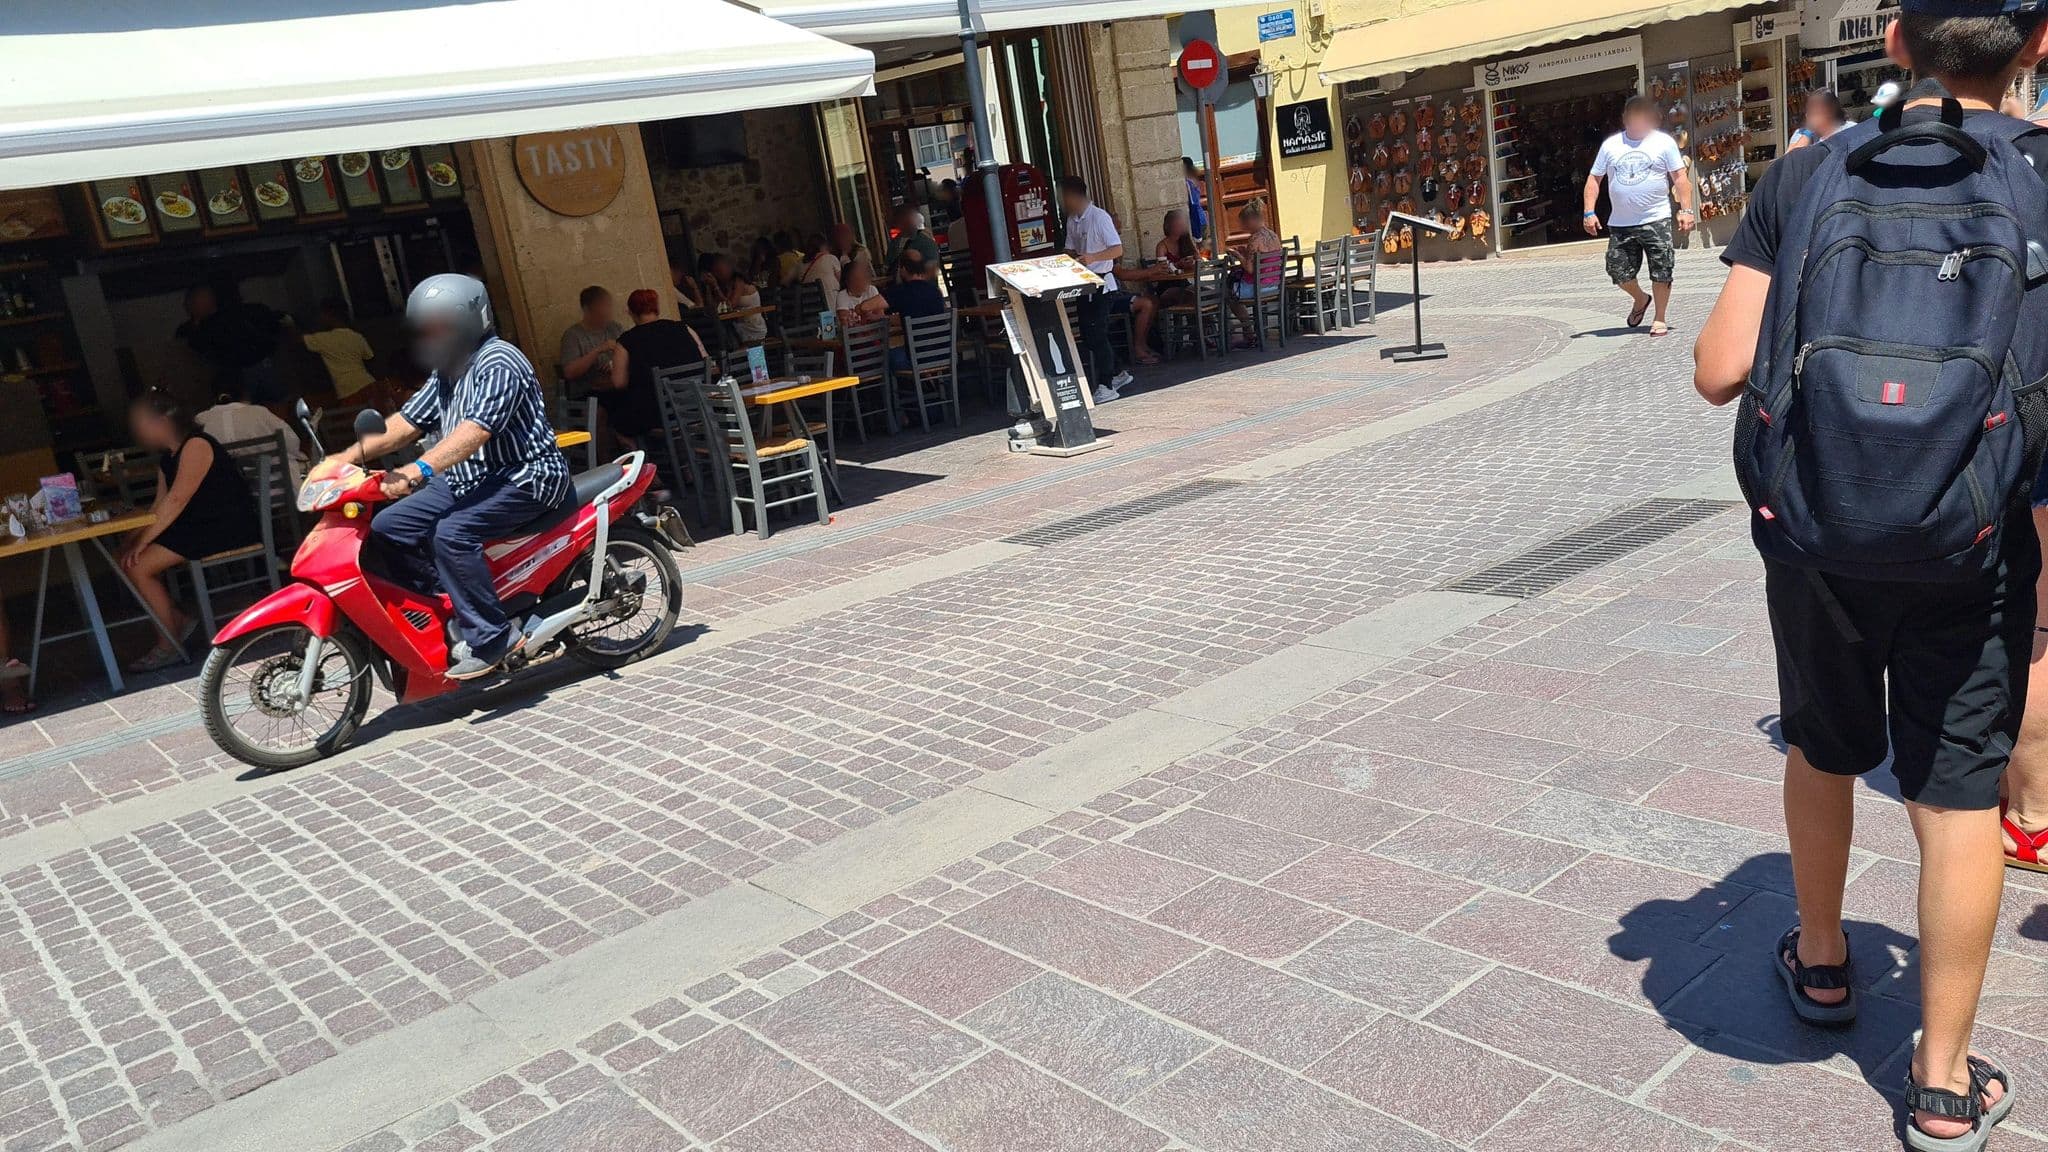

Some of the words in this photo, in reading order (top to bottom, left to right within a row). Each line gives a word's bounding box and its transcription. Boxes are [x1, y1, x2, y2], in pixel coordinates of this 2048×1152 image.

[1839, 16, 1873, 41] ARIEL
[1502, 61, 1530, 77] NIKOS
[1538, 57, 1572, 69] HANDMADE
[1574, 52, 1602, 62] LEATHER
[1604, 46, 1633, 57] SANDALS
[525, 136, 613, 177] TASTY
